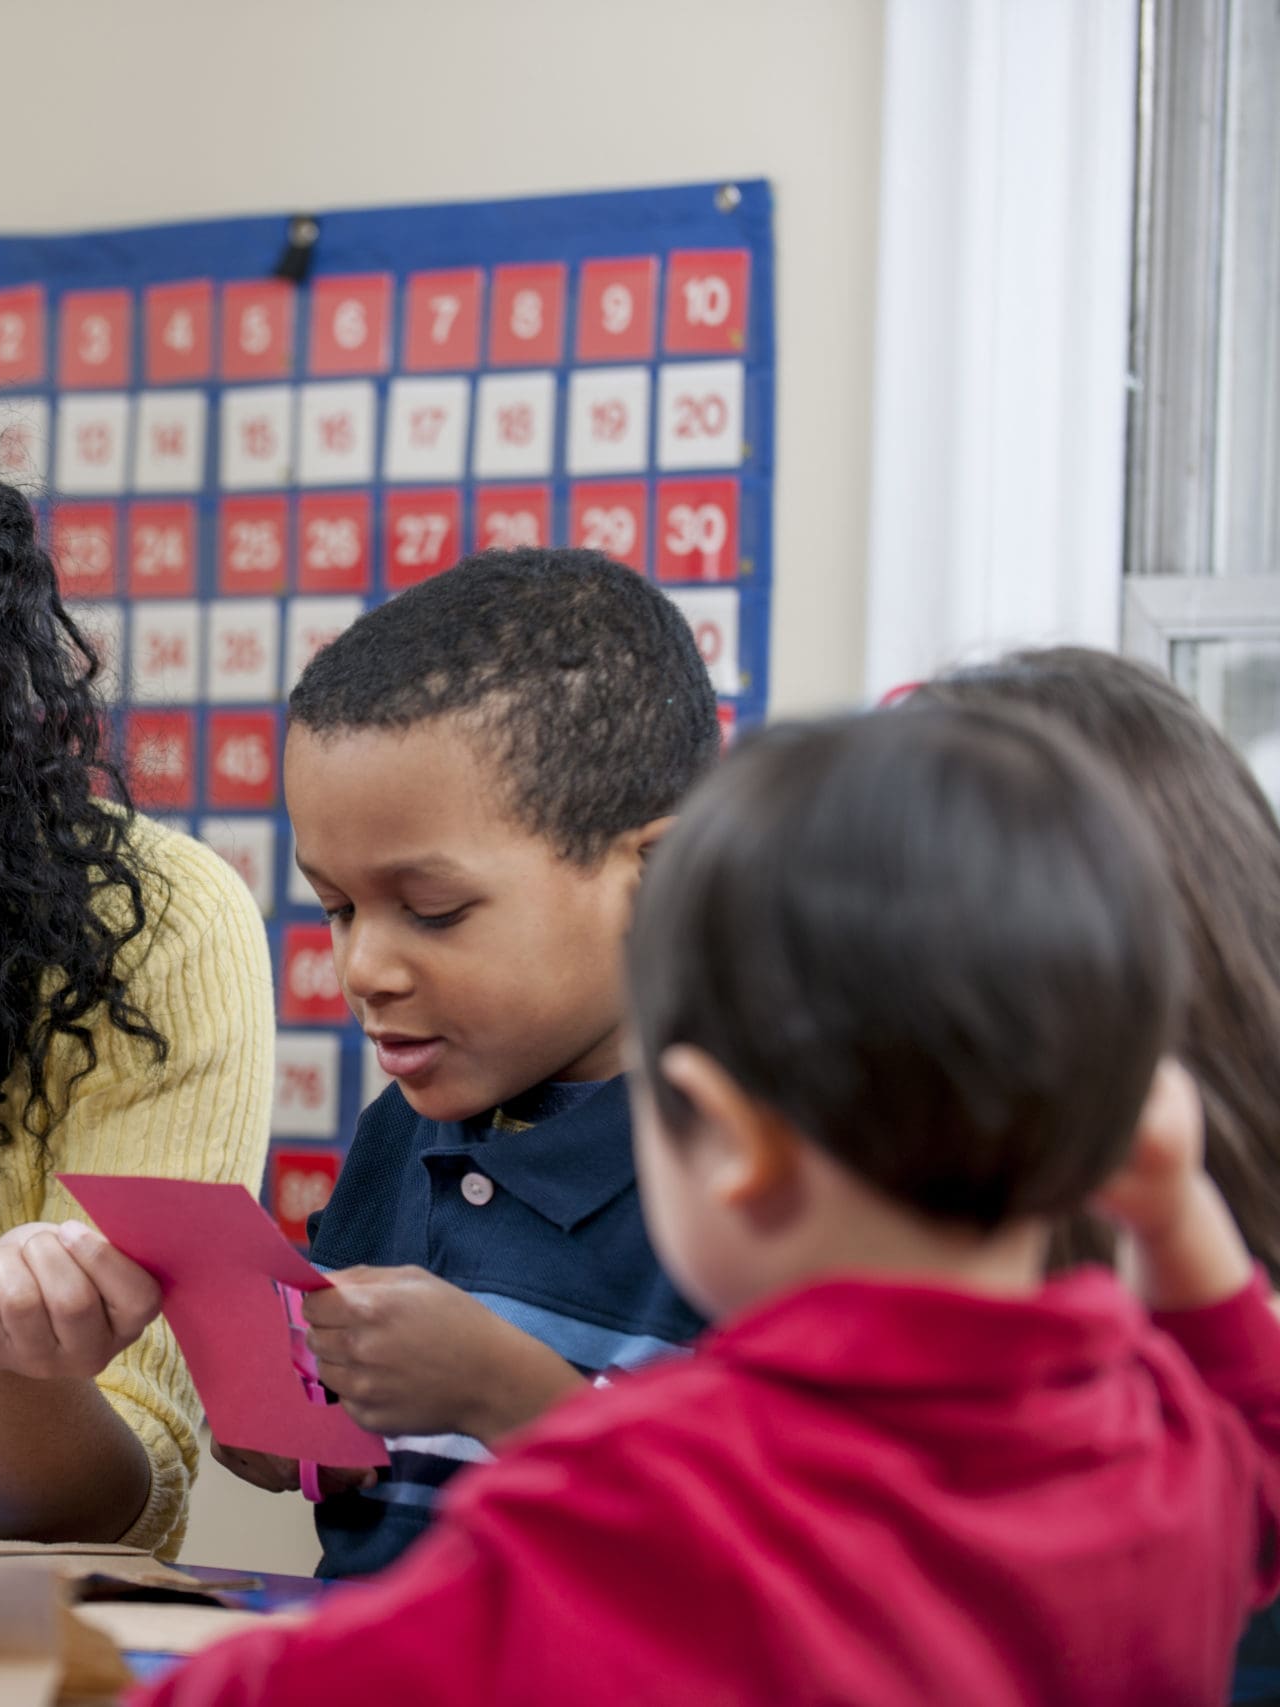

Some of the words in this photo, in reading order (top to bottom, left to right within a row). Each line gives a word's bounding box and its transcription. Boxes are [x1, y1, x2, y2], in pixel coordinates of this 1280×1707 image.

[79, 315, 111, 364] 3
[164, 308, 194, 354] 4
[239, 304, 272, 355] 5
[333, 300, 367, 349] 6
[429, 296, 459, 343] 7
[511, 290, 542, 339] 8
[602, 284, 633, 333] 9
[683, 276, 731, 326] 10
[409, 406, 448, 449] 17
[497, 402, 534, 447] 18
[590, 398, 628, 443] 19
[673, 393, 727, 441] 20
[134, 525, 186, 576] 24
[229, 519, 280, 572] 25
[306, 517, 361, 569] 26
[396, 513, 449, 565] 27
[581, 506, 636, 556] 29
[666, 504, 727, 555] 30
